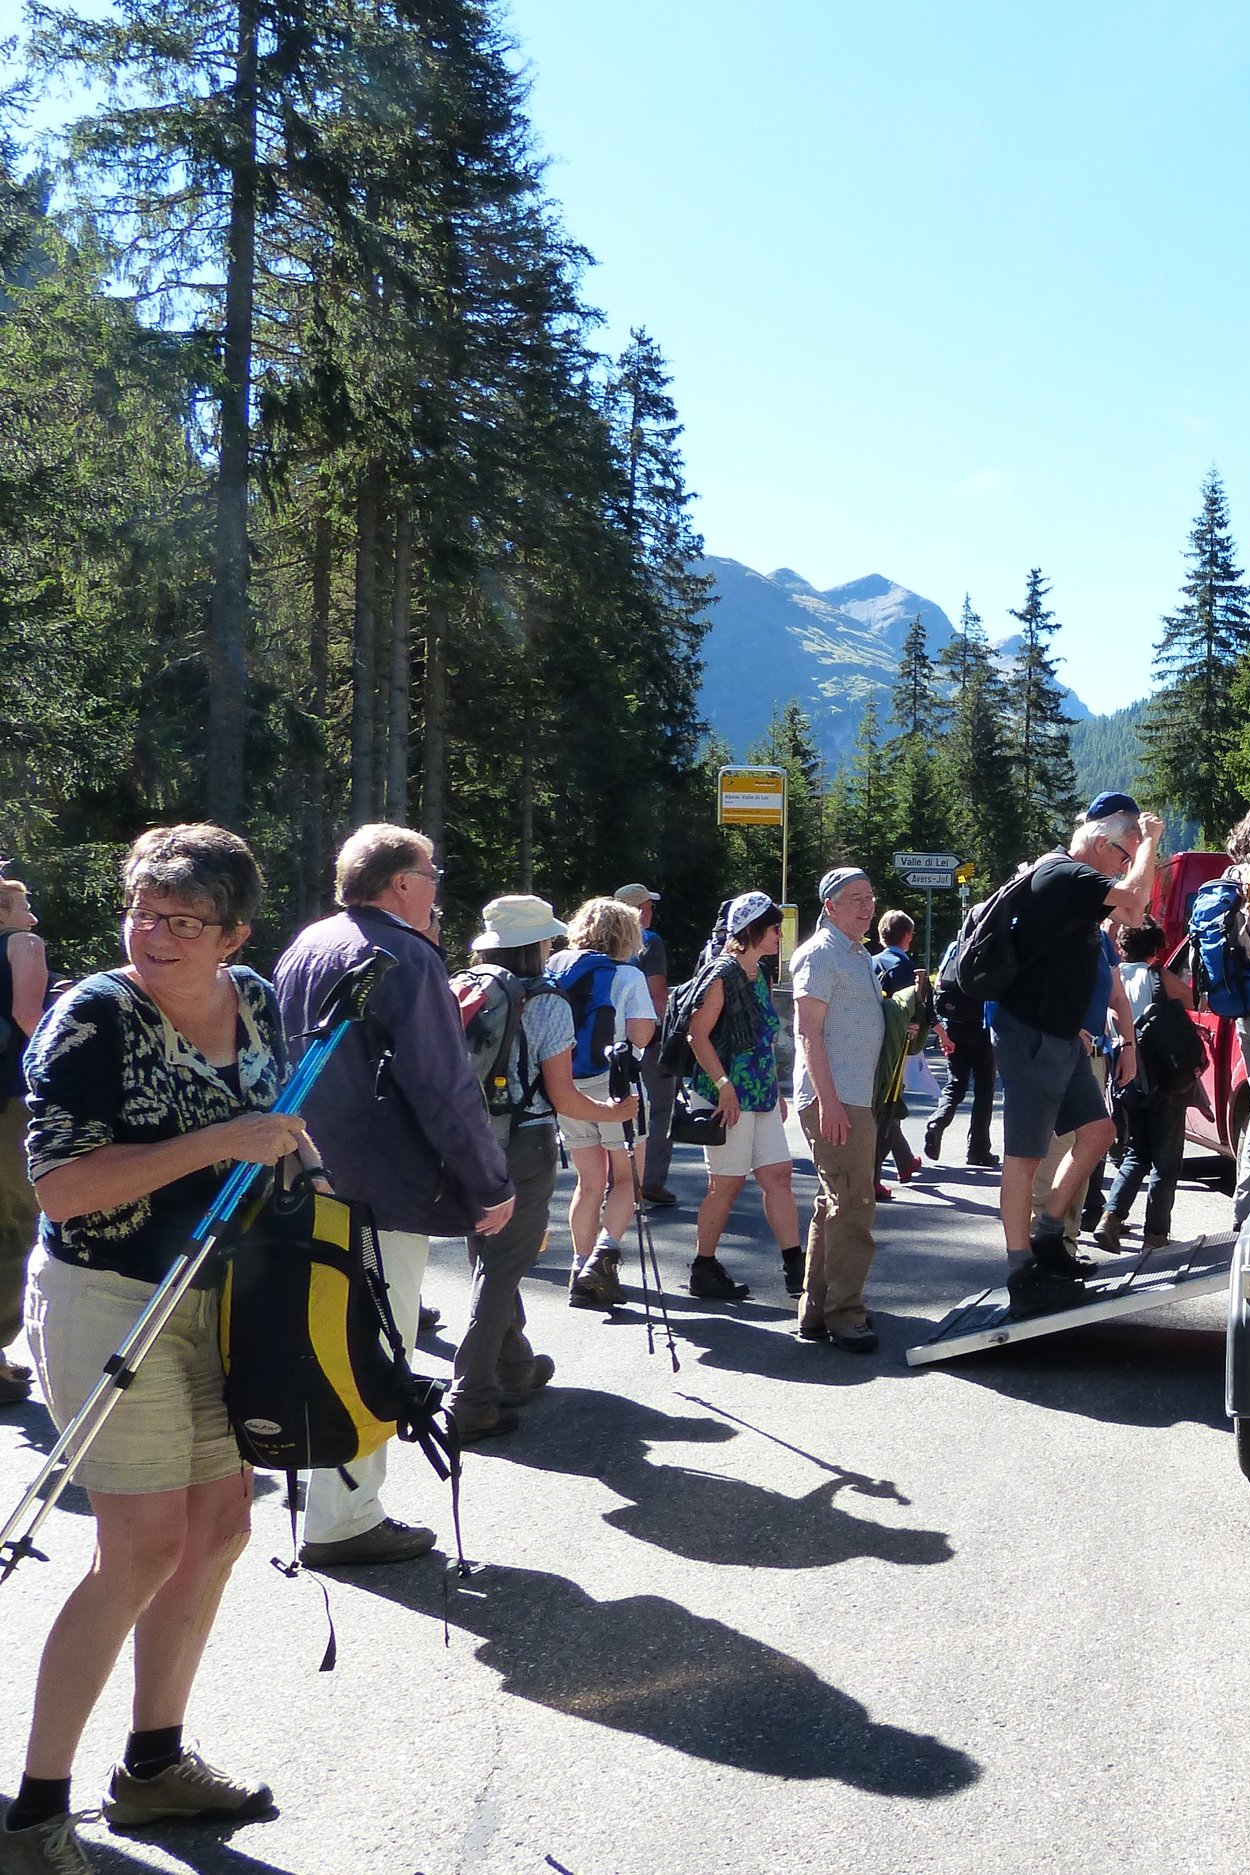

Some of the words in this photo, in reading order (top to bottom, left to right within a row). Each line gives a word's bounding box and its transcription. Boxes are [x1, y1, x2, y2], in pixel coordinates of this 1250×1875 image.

[901, 857, 921, 866] Valle
[925, 857, 932, 866] di
[936, 857, 949, 867] Lei
[912, 875, 948, 884] Avers-Juf
